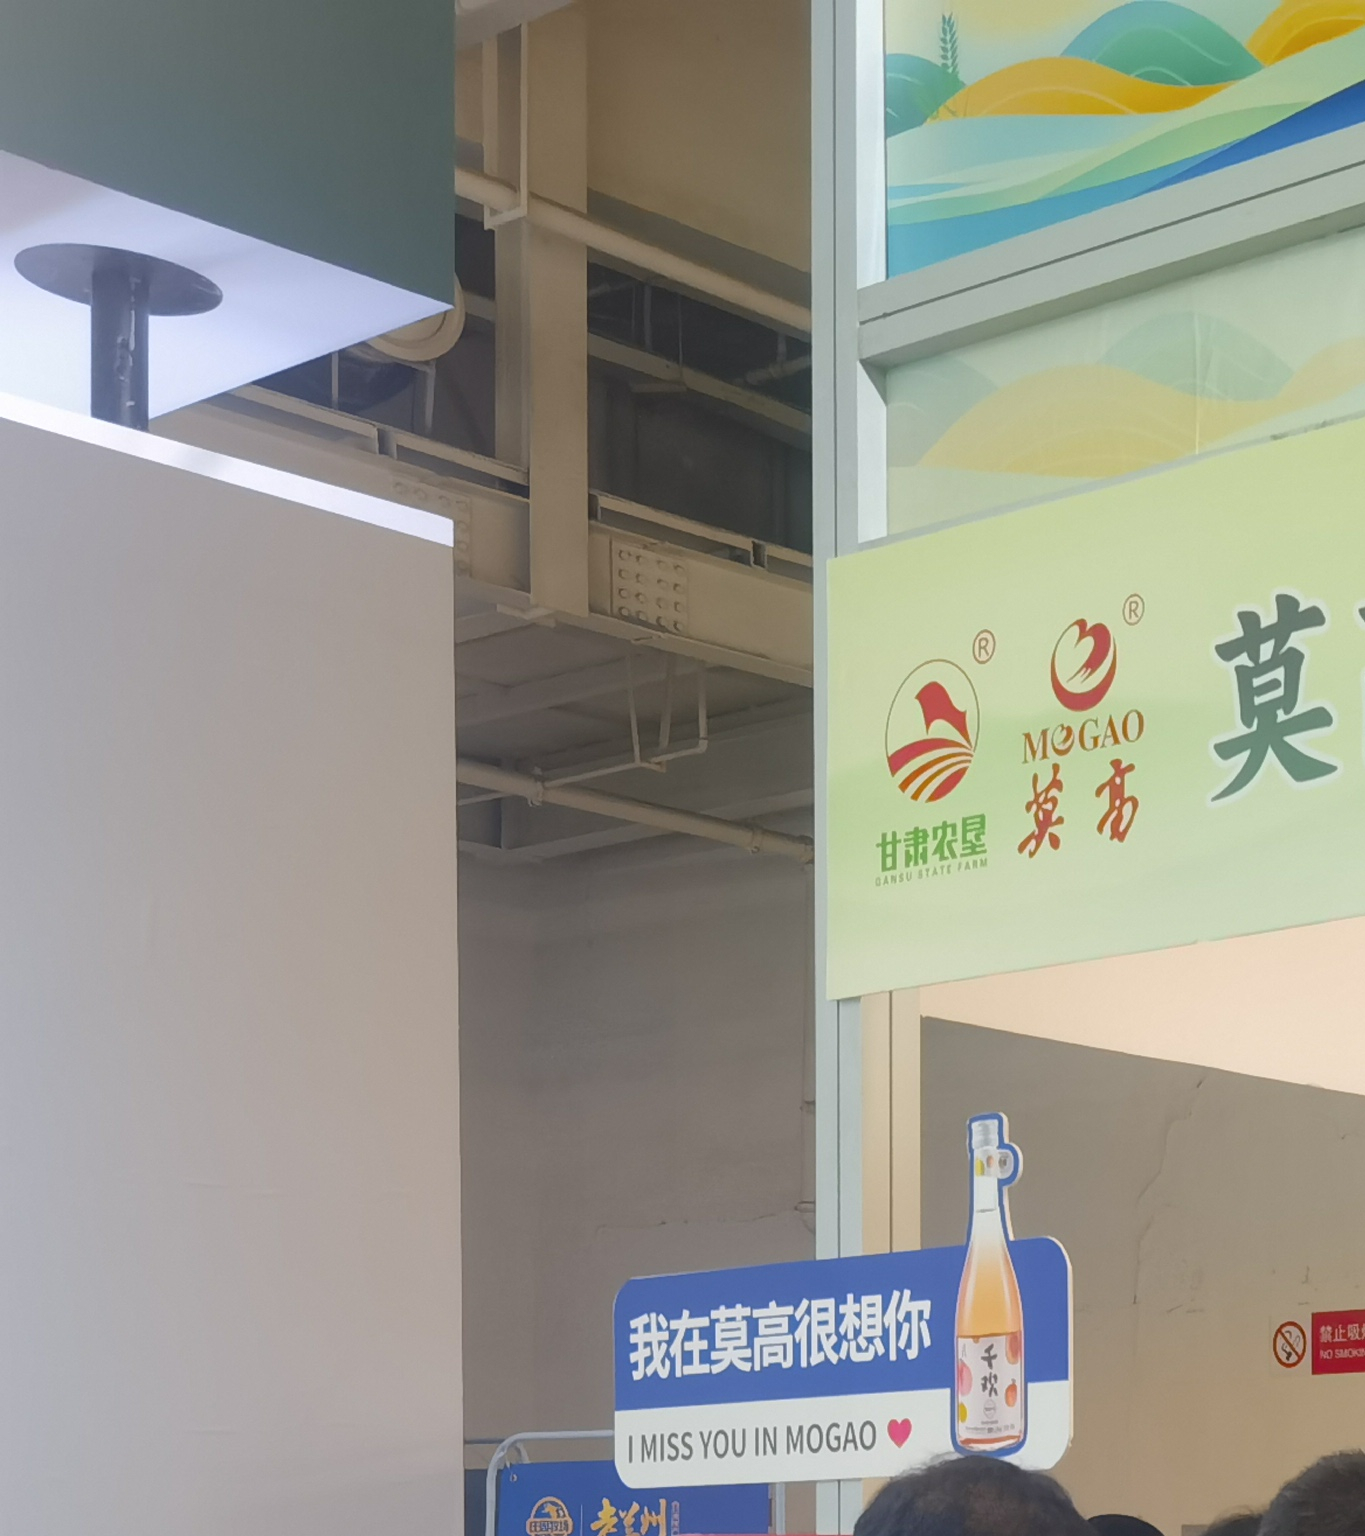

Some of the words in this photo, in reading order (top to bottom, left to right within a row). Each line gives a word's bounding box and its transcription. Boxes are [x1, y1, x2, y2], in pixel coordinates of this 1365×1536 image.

[1022, 709, 1145, 764] MOGAO
[875, 813, 988, 873] 甘肃农垦
[957, 857, 988, 873] FARM
[628, 1288, 932, 1381] 我在莫高很想你
[1320, 1349, 1333, 1360] NO
[627, 1434, 634, 1464] I
[641, 1430, 694, 1463] MISS
[699, 1427, 747, 1459] YOU
[754, 1424, 779, 1457] IN
[789, 1419, 877, 1454] MOGAO
